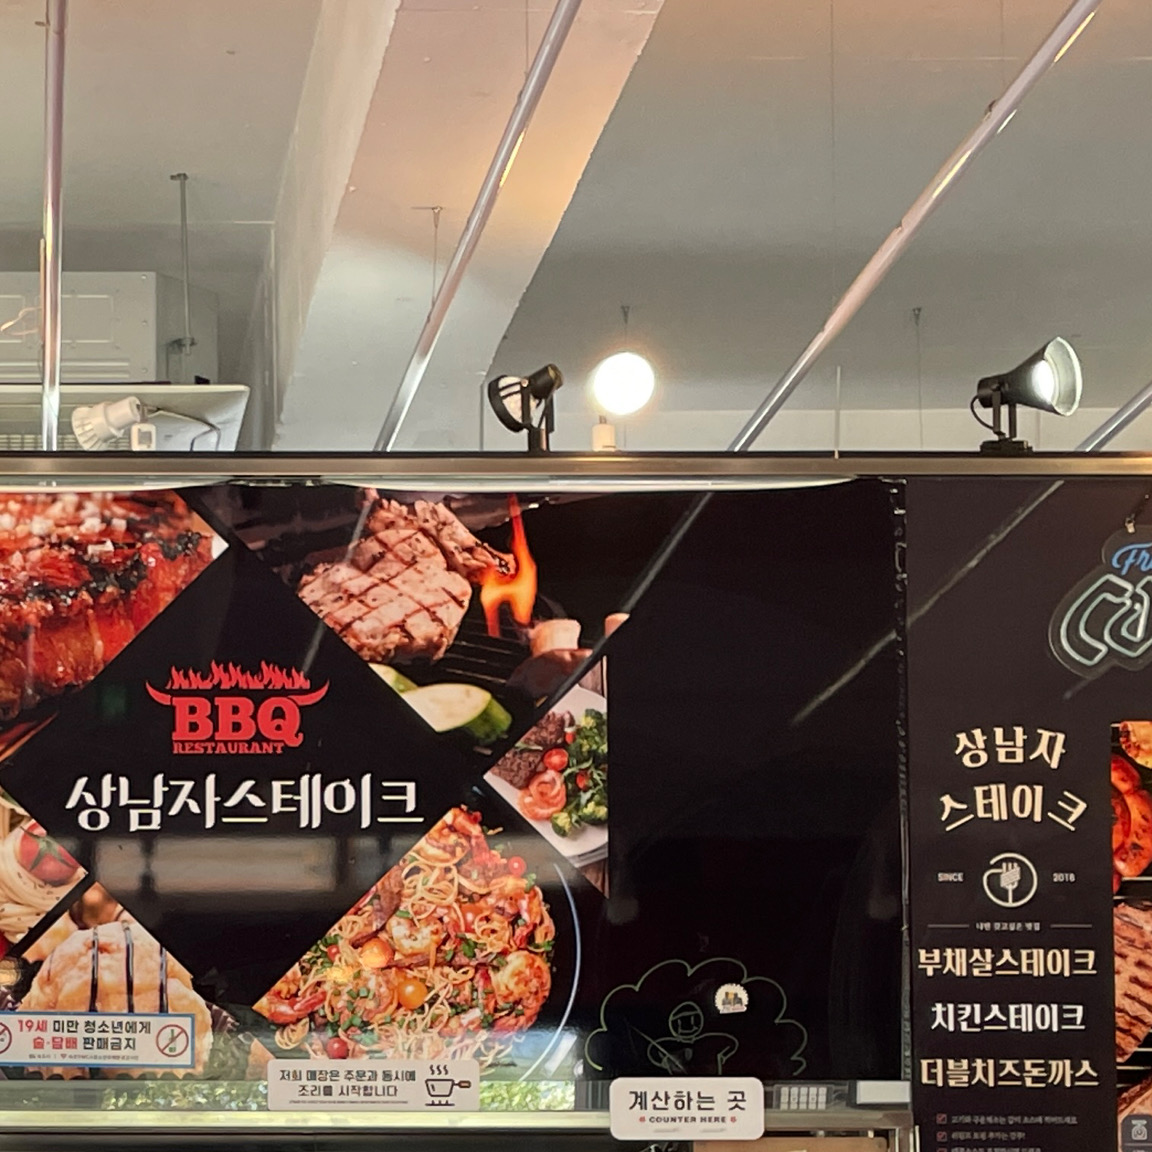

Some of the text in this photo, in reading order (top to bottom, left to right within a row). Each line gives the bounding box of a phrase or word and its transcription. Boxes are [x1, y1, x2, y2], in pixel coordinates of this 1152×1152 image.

[172, 697, 304, 748] BBQ
[172, 741, 284, 754] RESTAURANT
[955, 726, 1066, 769] 상남자
[65, 773, 425, 832] 상남자스테이크
[940, 783, 1087, 832] 스테이크
[938, 872, 963, 882] SINCE
[918, 948, 1098, 977] 부채살스테이크
[18, 1020, 151, 1034] 19세 미만 청소년에게
[931, 1003, 1086, 1032] 치킨스테이크
[82, 1037, 136, 1050] 판매금지
[279, 1070, 416, 1082] 저희 매장은 주문과 동시에
[920, 1058, 1100, 1088] 더블치즈돈까스
[298, 1085, 398, 1098] 조리를 시작합니다
[629, 1090, 747, 1112] 계산하는 곳
[649, 1116, 727, 1124] COUNTER HERE
